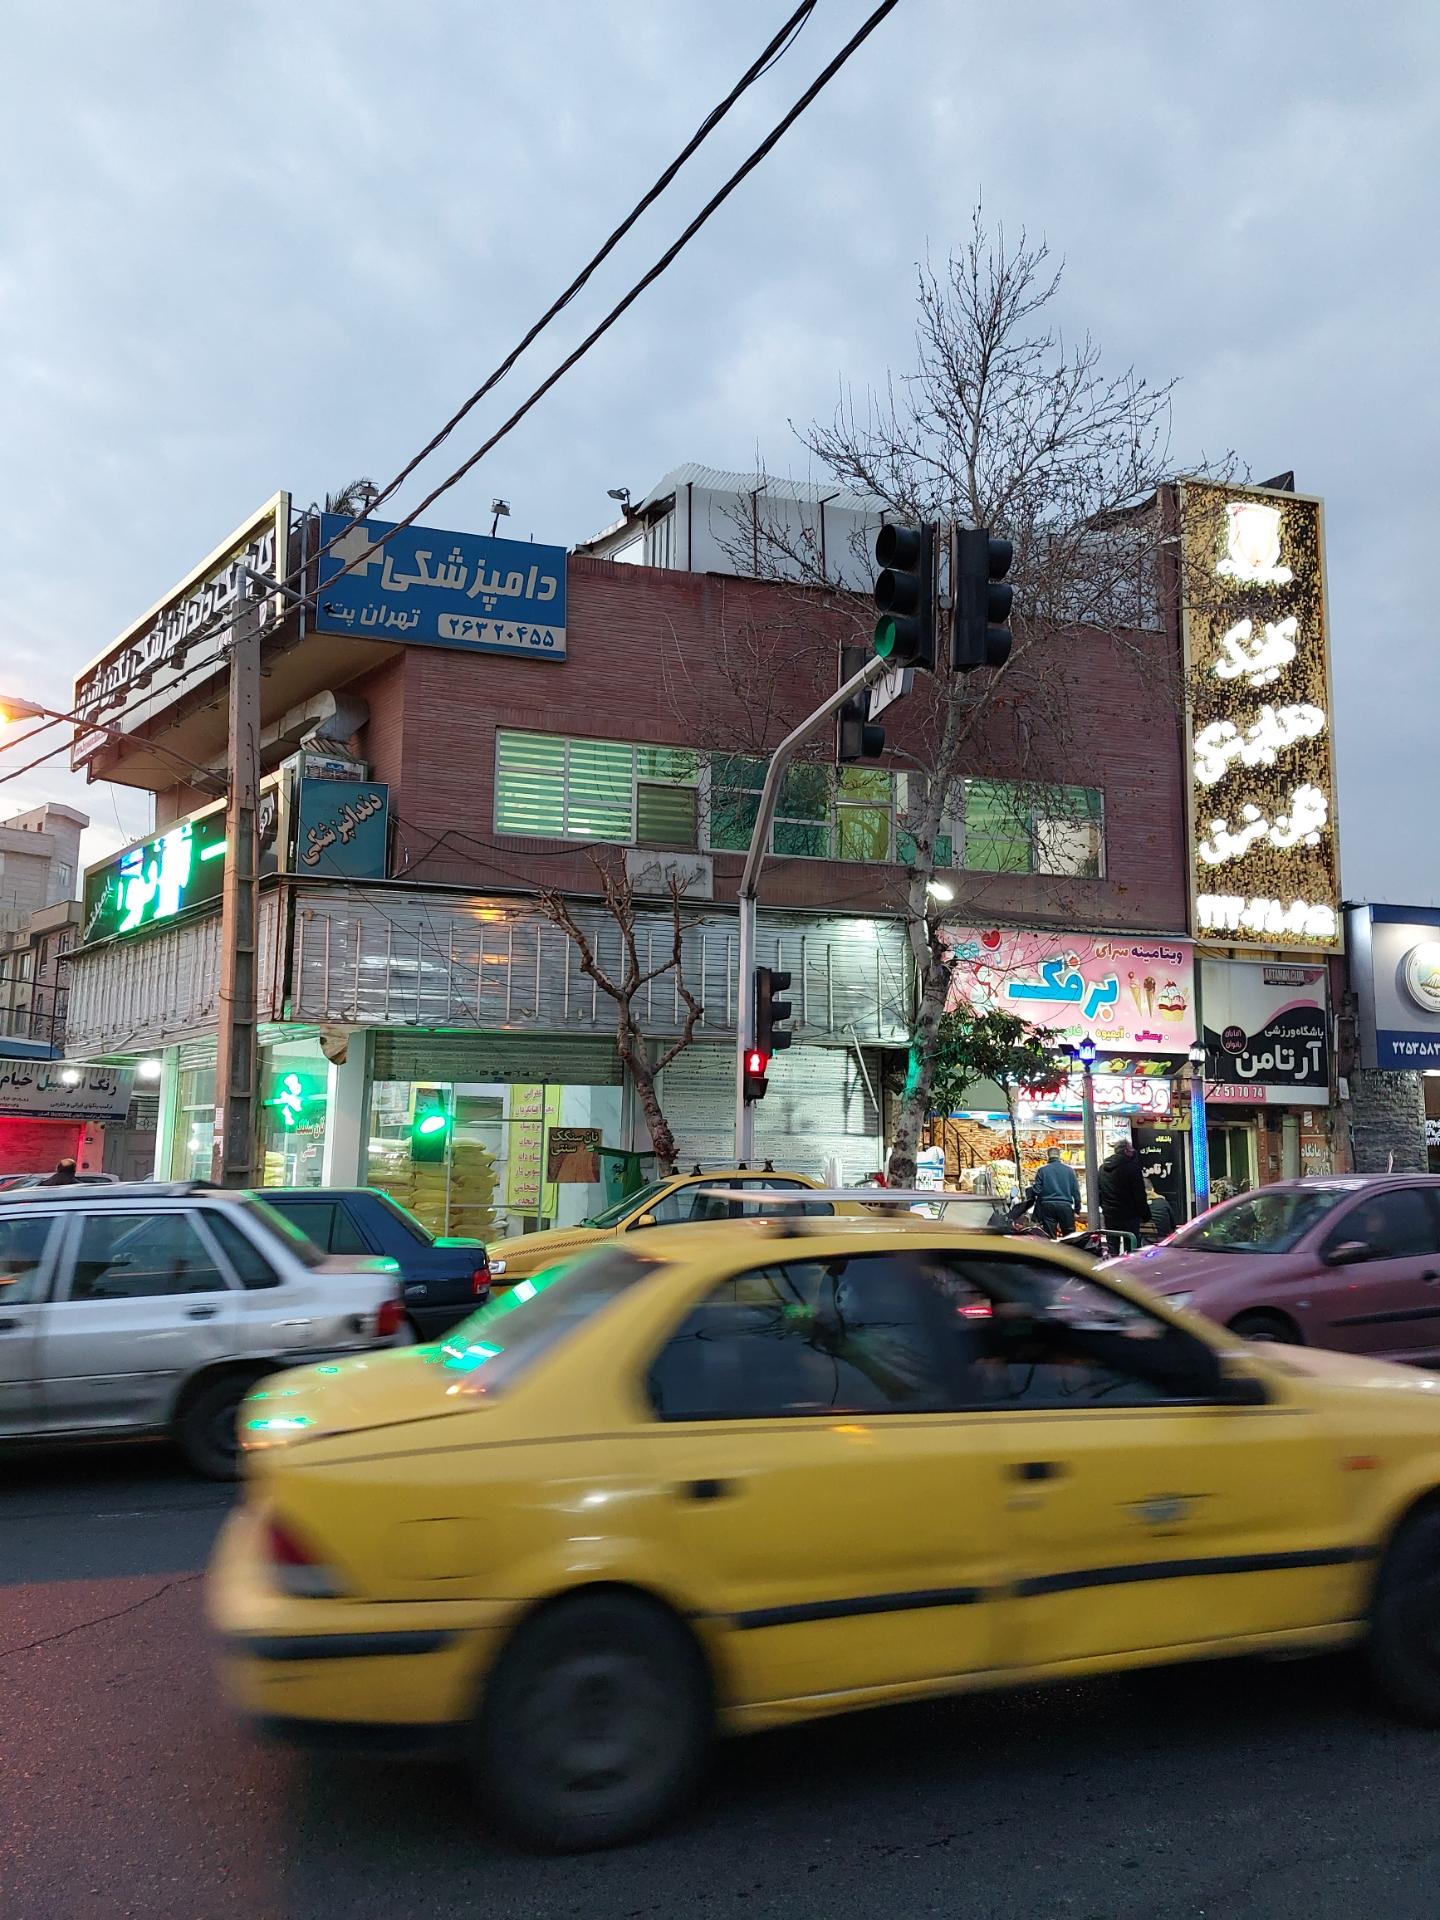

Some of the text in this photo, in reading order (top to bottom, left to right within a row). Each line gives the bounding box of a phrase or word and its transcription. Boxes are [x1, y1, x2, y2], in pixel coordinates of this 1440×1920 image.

[380, 547, 557, 612] دامپزشکی
[327, 602, 421, 631] تهران پت
[301, 792, 384, 867] دندانپزشکی
[1095, 943, 1183, 965] ویتامینه سرای
[1006, 955, 1120, 1021] برفک
[1095, 1026, 1125, 1042] آبمیوه
[1135, 1029, 1163, 1042] بستنی
[1265, 1025, 1324, 1039] باشگاه ورزشی
[1235, 1041, 1322, 1080] آرتامن
[0, 1072, 33, 1090] خیام
[90, 1077, 117, 1096] رنگ
[1225, 1086, 1235, 1097] 51
[1239, 1087, 1249, 1098] 70
[1253, 1087, 1263, 1098] 74
[552, 1130, 599, 1144] نان سنگک
[1155, 1135, 1172, 1144] باشگاه
[550, 1143, 577, 1155] سنتی
[1141, 1162, 1173, 1178] آرتامن
